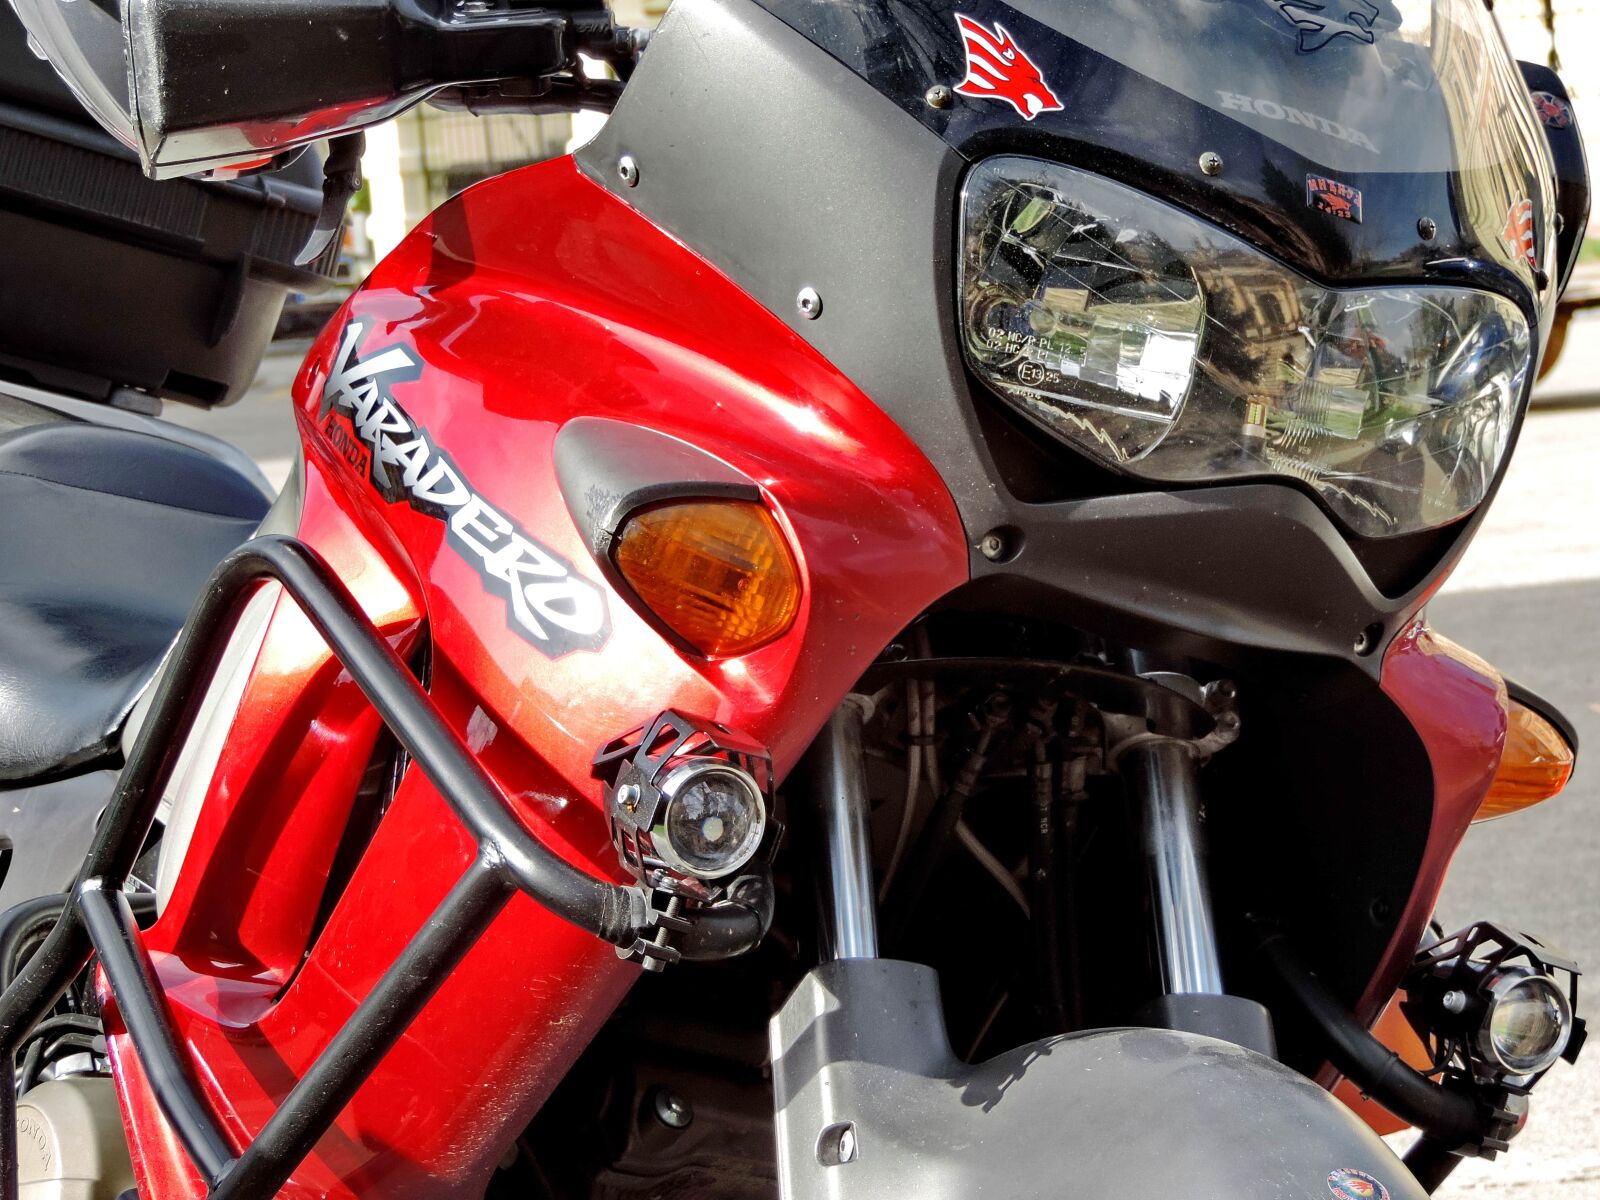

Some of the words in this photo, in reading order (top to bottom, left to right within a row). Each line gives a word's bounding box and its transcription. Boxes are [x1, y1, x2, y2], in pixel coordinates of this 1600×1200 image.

[1216, 90, 1381, 155] HONDA
[324, 414, 368, 479] HONDA
[323, 321, 605, 641] VARADERO
[17, 1117, 52, 1172] ONDA
